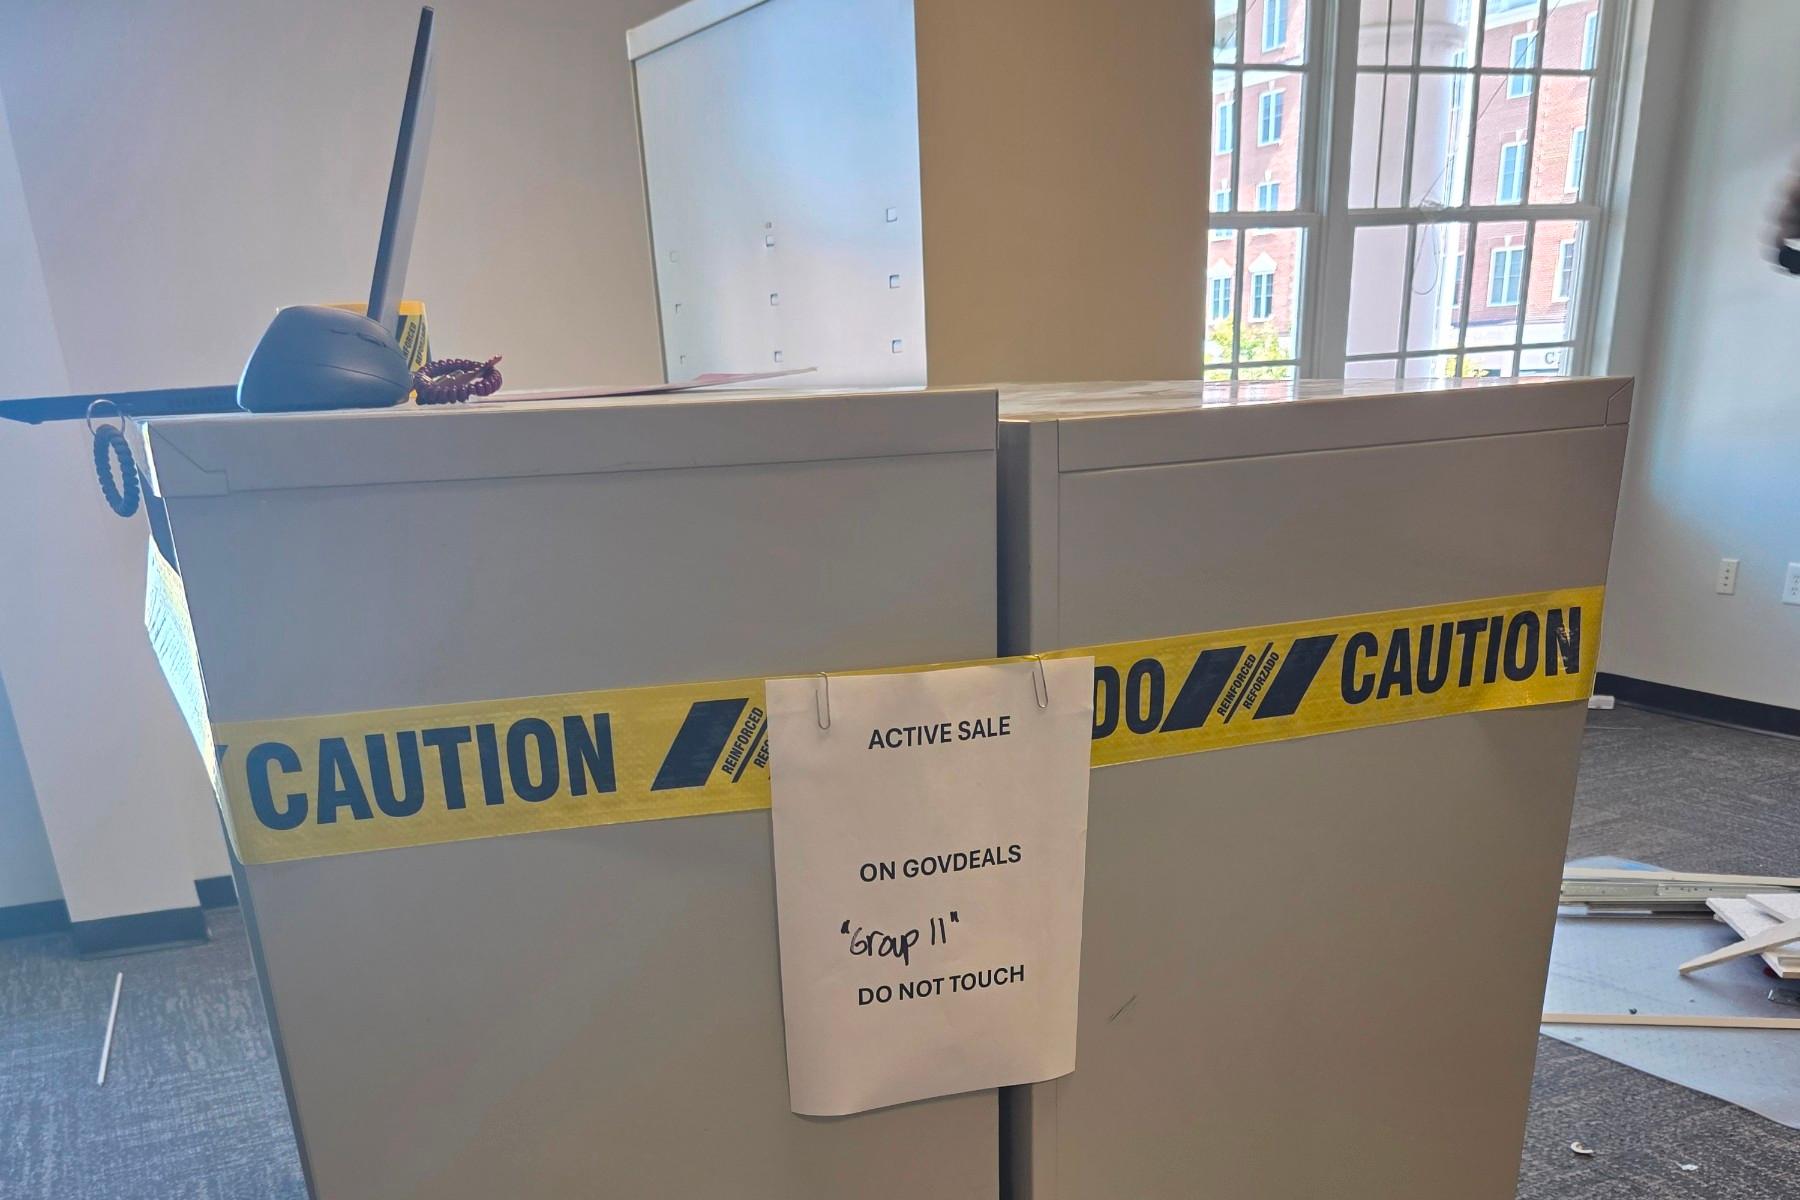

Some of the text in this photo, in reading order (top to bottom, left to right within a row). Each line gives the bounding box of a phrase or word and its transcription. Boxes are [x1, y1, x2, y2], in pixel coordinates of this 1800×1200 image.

[1216, 653, 1257, 717] REINFORCED
[1242, 651, 1280, 710] REFORZADO
[1341, 607, 1582, 704] CAUTION
[721, 706, 764, 775] REINFORCED
[868, 715, 1011, 750] ACTIVE SALE
[246, 713, 617, 830] CAUTION
[859, 844, 1022, 883] ON GOVDEALS
[858, 964, 1025, 1006] DO NOT TOUCH
